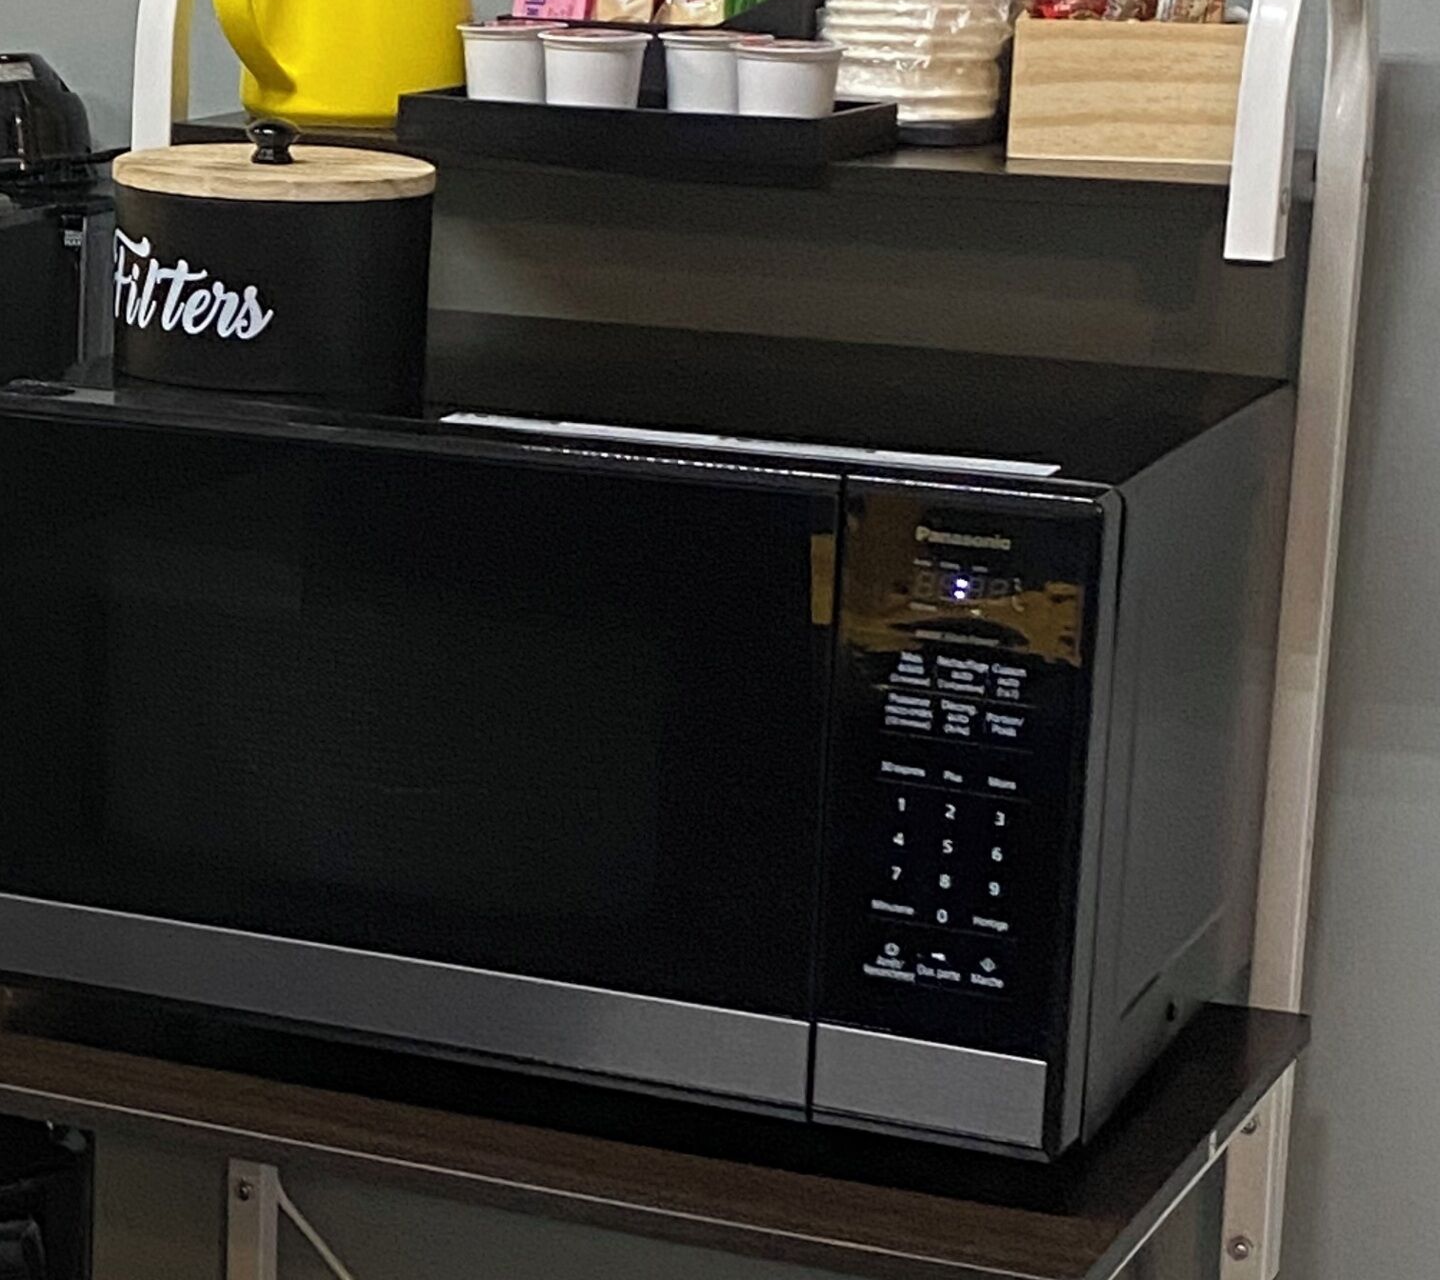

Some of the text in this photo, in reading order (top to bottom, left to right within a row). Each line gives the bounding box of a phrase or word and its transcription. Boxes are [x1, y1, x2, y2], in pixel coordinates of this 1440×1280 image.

[113, 227, 274, 340] Filters
[898, 797, 1005, 826] 1 2 3
[893, 832, 1003, 862] 4 5 6
[891, 865, 1000, 896] 7 8 9
[936, 908, 948, 923] 0
